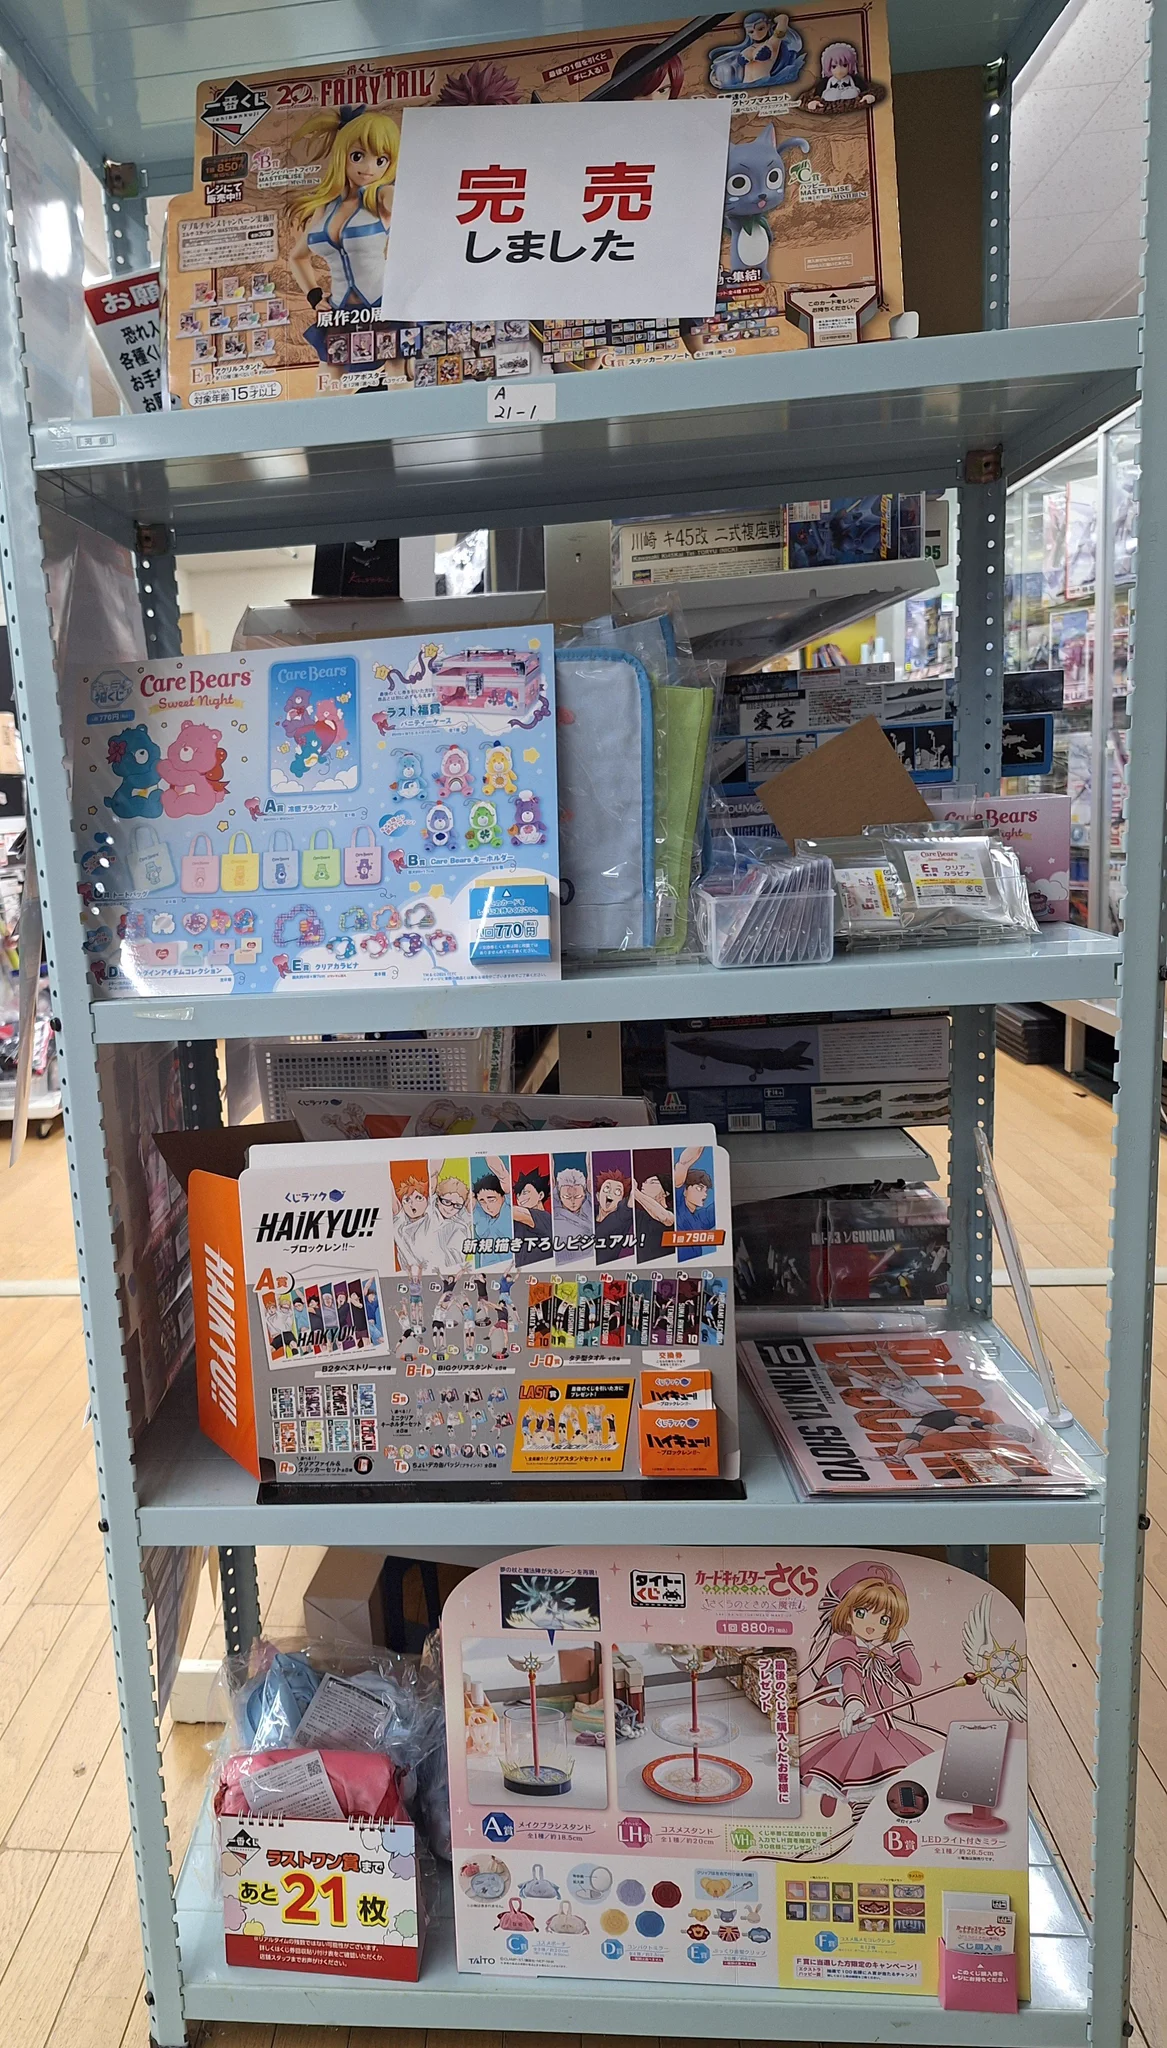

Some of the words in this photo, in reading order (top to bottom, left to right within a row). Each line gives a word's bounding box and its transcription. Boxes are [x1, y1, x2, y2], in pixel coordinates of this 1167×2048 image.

[320, 74, 381, 107] FAIRY
[385, 66, 437, 99] TAIL
[205, 92, 268, 112] 一番くじ
[206, 183, 244, 195] レジにて
[800, 185, 851, 196] MASTERLISE
[206, 192, 243, 204] 販売中!!
[465, 229, 635, 263] しました
[808, 297, 859, 308] このカードをレジに
[629, 353, 690, 365] ステッカーアソート
[214, 362, 263, 375] アクリルスタンド
[342, 371, 387, 383] クリアポスター
[193, 386, 277, 406] 対象年齢15才以上
[494, 387, 506, 401] A
[493, 405, 537, 421] 21-1
[631, 530, 657, 552] 川崎
[663, 527, 708, 547] キ45改
[715, 521, 781, 543] 二式複座戦
[278, 668, 306, 684] Care
[308, 665, 348, 679] Bears
[140, 674, 186, 698] Care
[189, 670, 251, 694] Bears
[158, 696, 195, 710] Sweet
[198, 693, 235, 709] Night
[386, 702, 441, 718] ラスト福賞
[400, 717, 452, 727] バニティーケース
[753, 707, 796, 732] 愛宕
[287, 802, 339, 813] 冷感ブランケット
[985, 809, 1038, 828] Bears
[430, 857, 448, 865] Care
[449, 856, 472, 864] Bears
[473, 853, 515, 864] キーホルダー
[937, 850, 958, 858] Bears
[315, 962, 359, 971] クリアカラビナ
[284, 1191, 328, 1204] くじラック
[462, 1233, 646, 1254] 新規描き下ろしビジュアル!
[671, 1231, 715, 1245] 1回790円
[255, 1266, 289, 1292] A賞
[591, 1336, 598, 1346] 2
[651, 1334, 658, 1345] 5
[687, 1334, 698, 1345] 10
[569, 1354, 606, 1362] タテ型タオル
[659, 1352, 683, 1360] 交換券
[762, 1344, 805, 1364] 10
[322, 1364, 377, 1373] B2タペストリー
[437, 1363, 493, 1372] BIGクリアスタンド
[655, 1378, 680, 1387] くじラック
[519, 1384, 559, 1401] LAST賞
[571, 1385, 624, 1393] 最後のくじを引いた方に
[774, 1368, 833, 1421] HINATA
[655, 1418, 687, 1428] くじラック
[797, 1425, 871, 1482] SHOYO
[500, 1566, 598, 1576] 夢の杖と魔法陣が光るシーンを再現!
[635, 1574, 682, 1587] タイトー
[695, 1569, 767, 1587] カードキャプター
[766, 1562, 819, 1598] さくら
[635, 1587, 660, 1600] くじ
[758, 1658, 773, 1713] プレゼント
[774, 1658, 790, 1804] 最後のくじを購入したお客様に
[484, 1817, 514, 1838] A賞
[518, 1821, 592, 1832] メイクブラシスタンド
[660, 1825, 714, 1835] コスメスタンド
[227, 1833, 259, 1848] 一番くじ
[886, 1830, 917, 1850] B賞
[922, 1835, 1007, 1846] LEDライト付きミラー
[985, 1925, 1007, 1937] さくら
[628, 1944, 669, 1952] コンパクトミラー
[957, 1942, 1003, 1952] くじ購入券
[260, 1953, 348, 1967] 店舗スタッフまでお声がけください。
[468, 1956, 496, 1966] TAITO
[796, 1958, 918, 1971] F賞に当選した方限定のキャンペーン!
[952, 1975, 1009, 1984] レジにお持ちください
[957, 1969, 1003, 1977] このくじ購入券を
